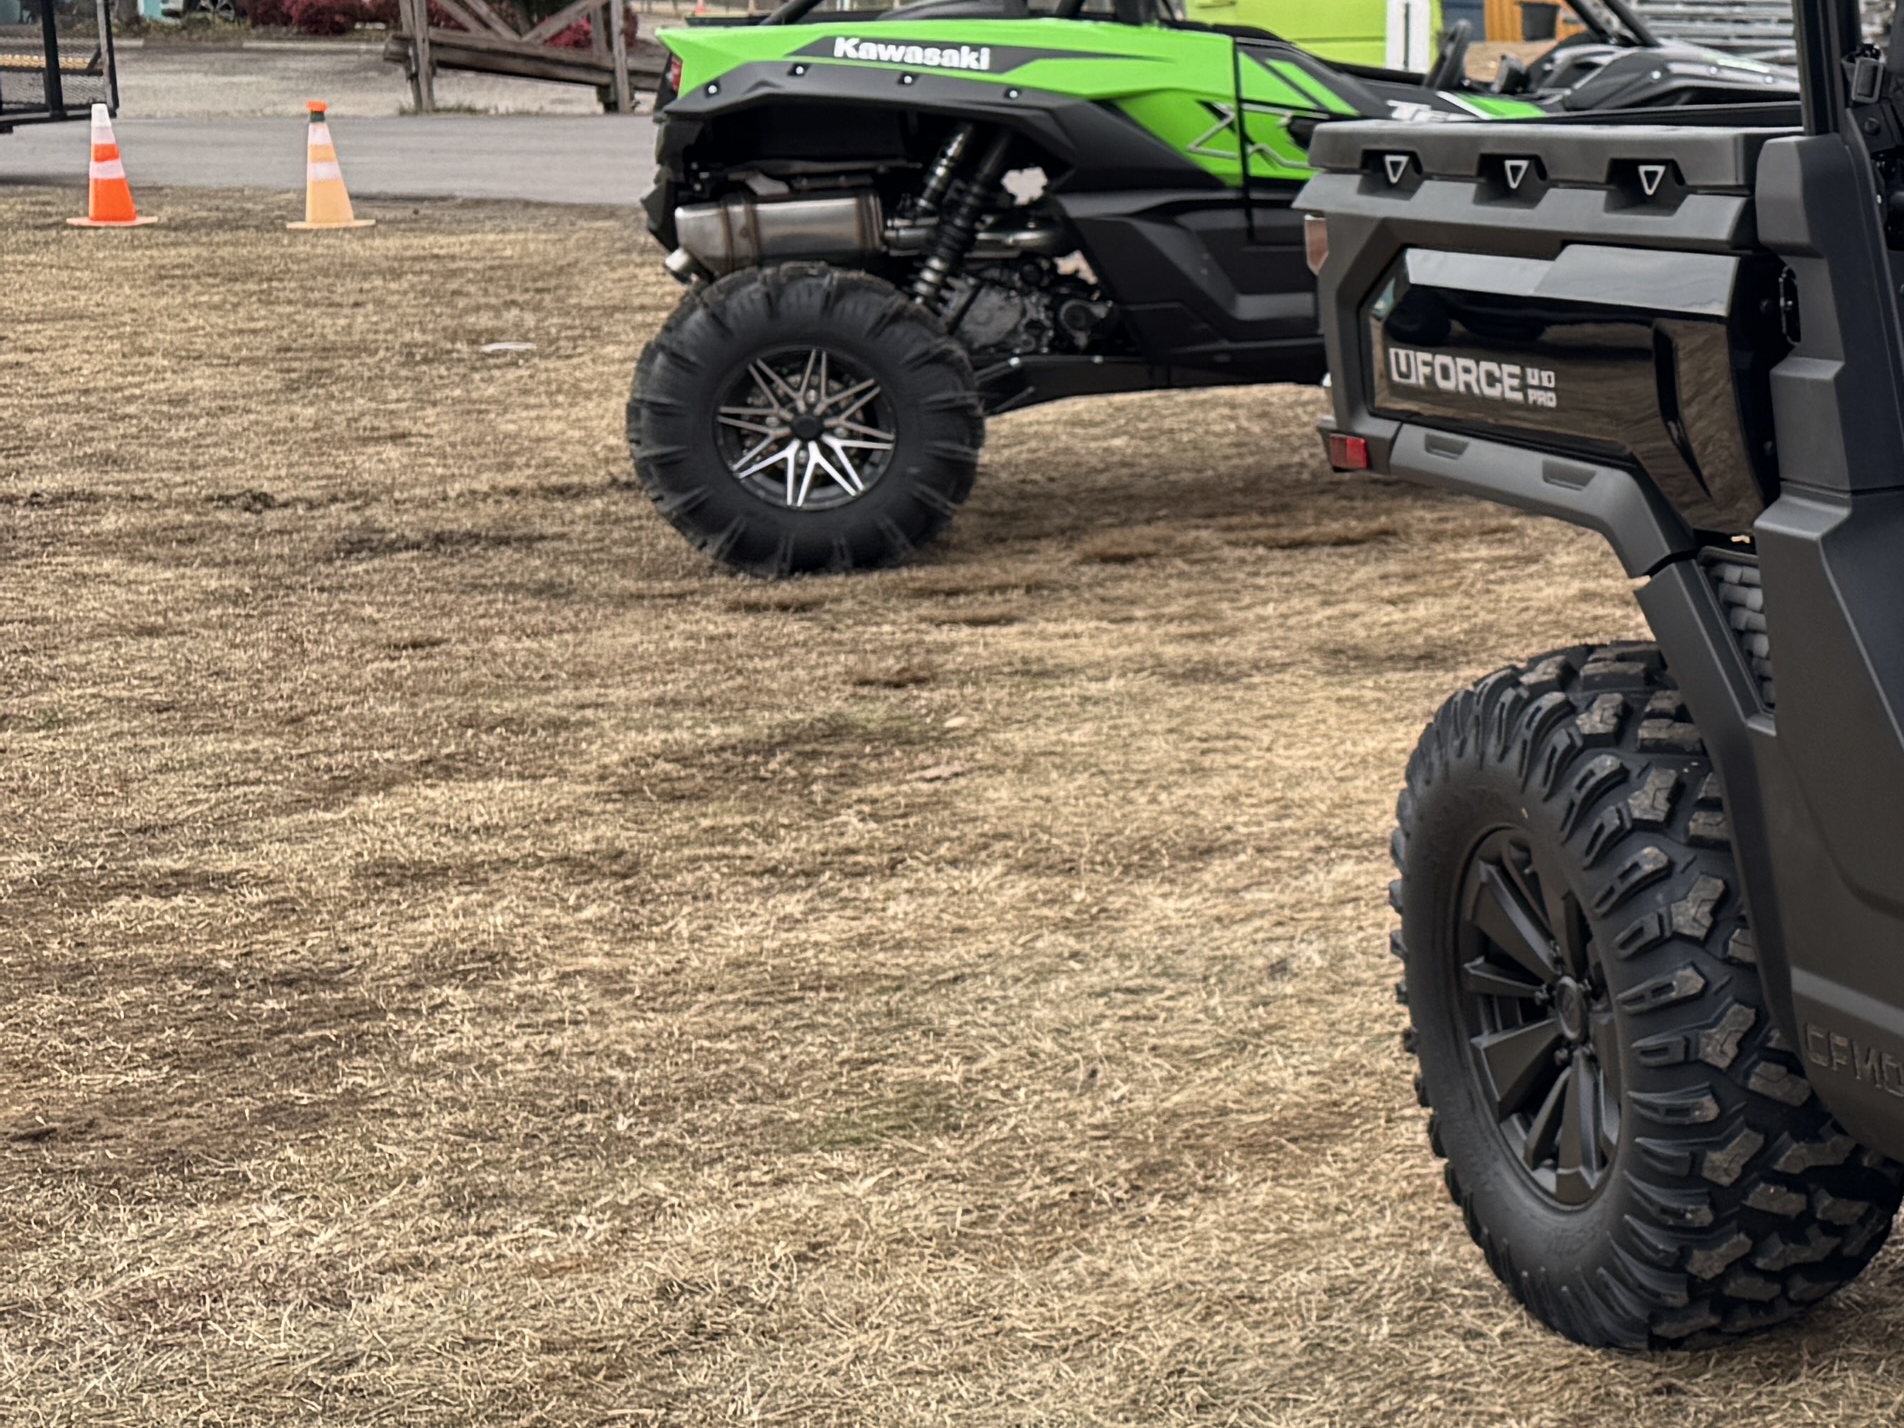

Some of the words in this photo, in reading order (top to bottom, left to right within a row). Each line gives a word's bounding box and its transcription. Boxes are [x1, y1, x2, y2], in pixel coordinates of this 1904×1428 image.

[833, 36, 991, 71] Kawasaki
[1389, 347, 1524, 403] UFORCE
[1528, 388, 1557, 408] PRO
